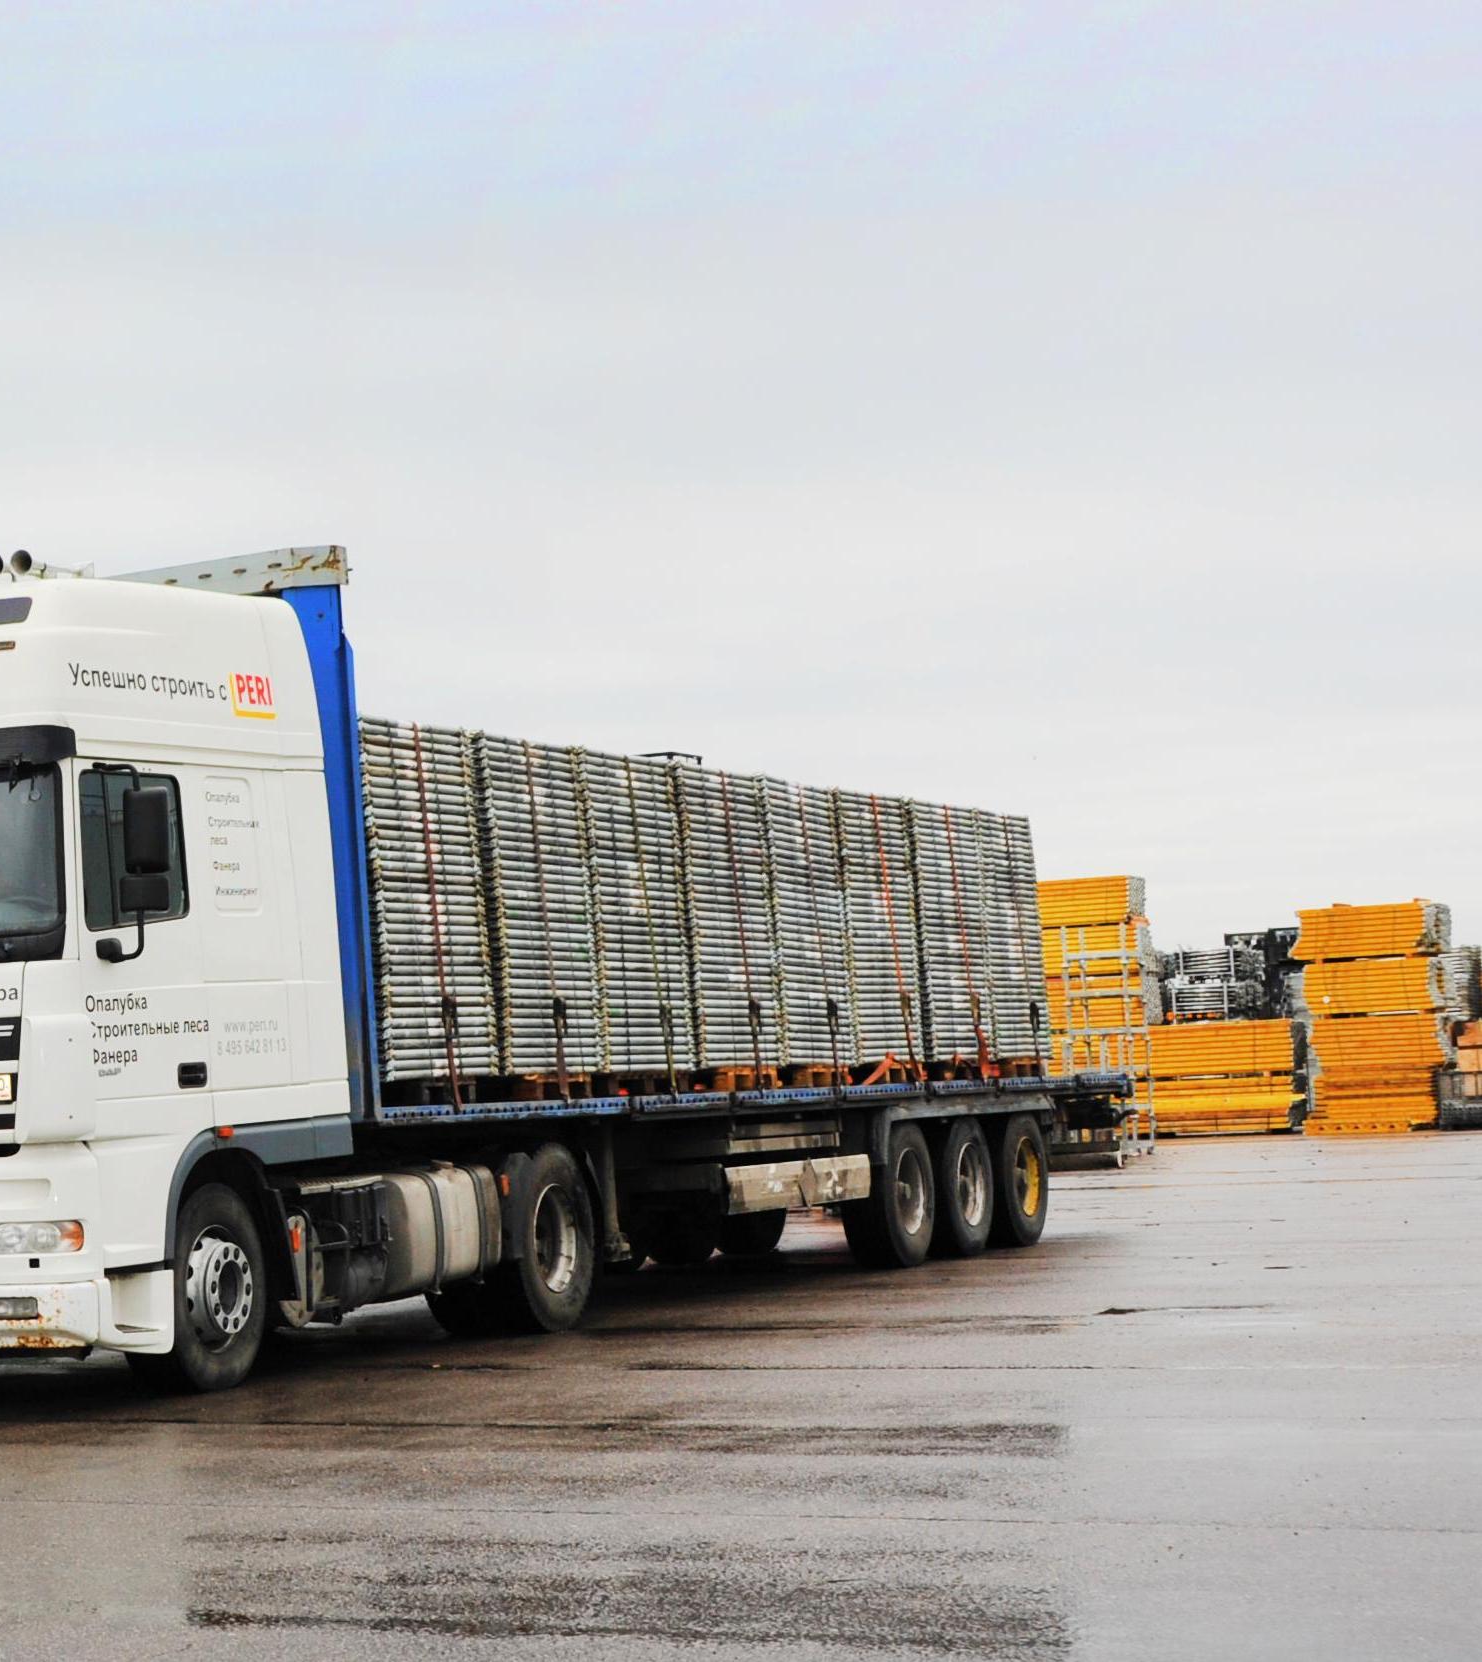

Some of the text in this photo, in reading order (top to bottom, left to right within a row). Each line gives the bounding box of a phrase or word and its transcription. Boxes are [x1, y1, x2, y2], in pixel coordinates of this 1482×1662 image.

[68, 662, 273, 706] Успешно строить с PERI
[85, 993, 148, 1016] Опалубка
[183, 1019, 209, 1033] леса
